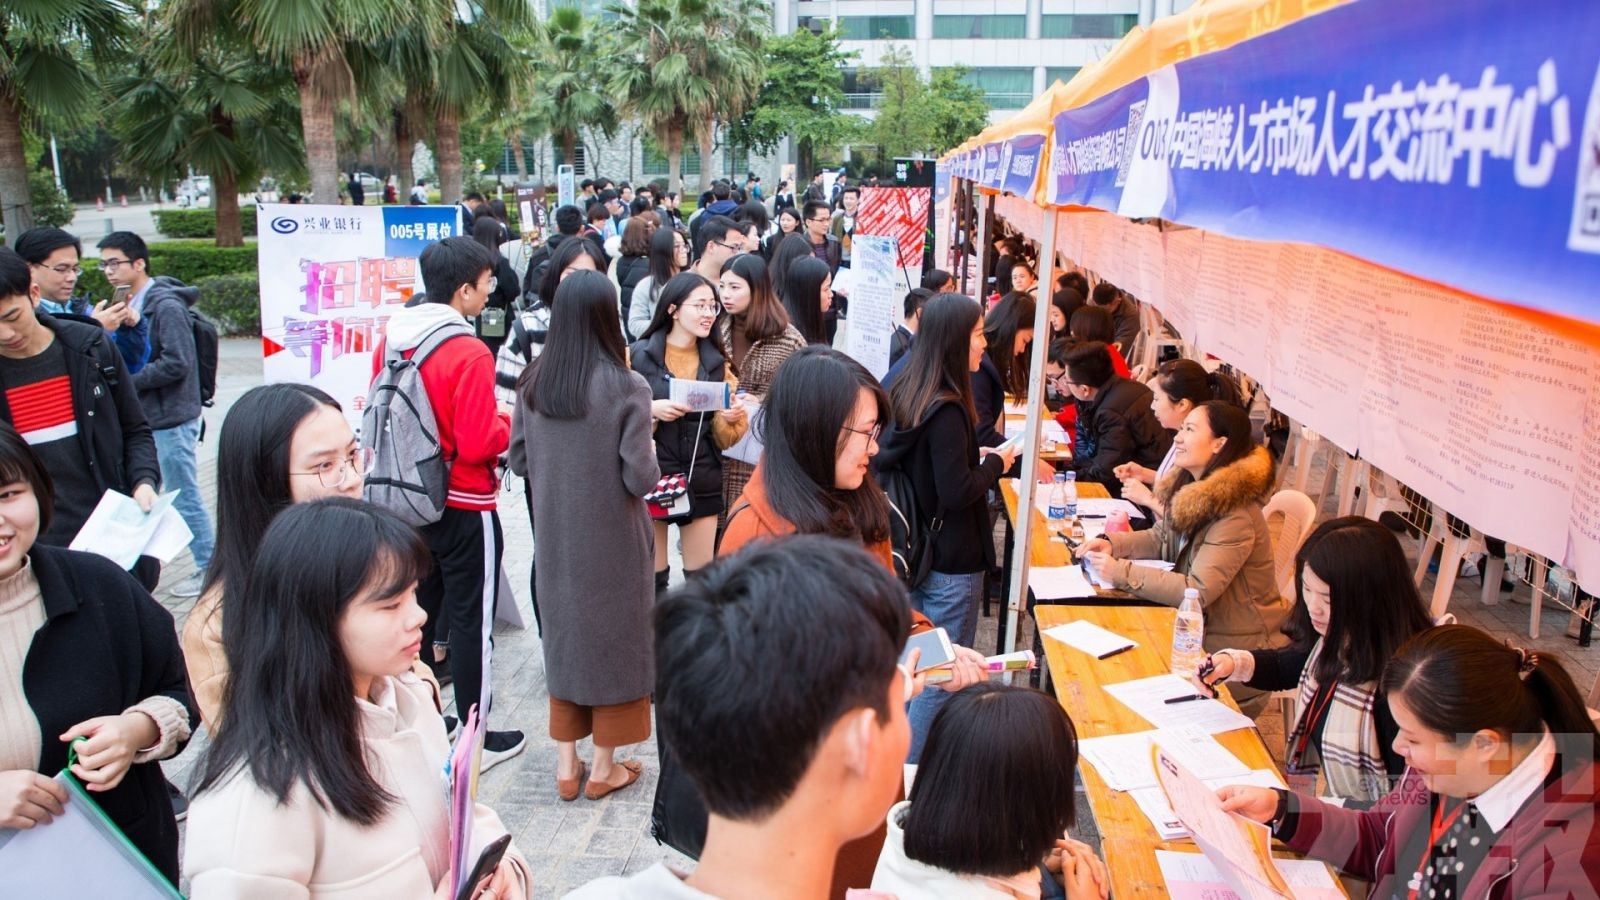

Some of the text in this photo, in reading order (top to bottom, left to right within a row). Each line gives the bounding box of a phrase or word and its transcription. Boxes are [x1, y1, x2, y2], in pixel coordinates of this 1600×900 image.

[1169, 57, 1571, 188] 中国海峡人才市场人才交流中心
[303, 216, 363, 231] 兴业银行
[390, 222, 452, 241] 005号展位
[299, 256, 417, 315] 招聘
